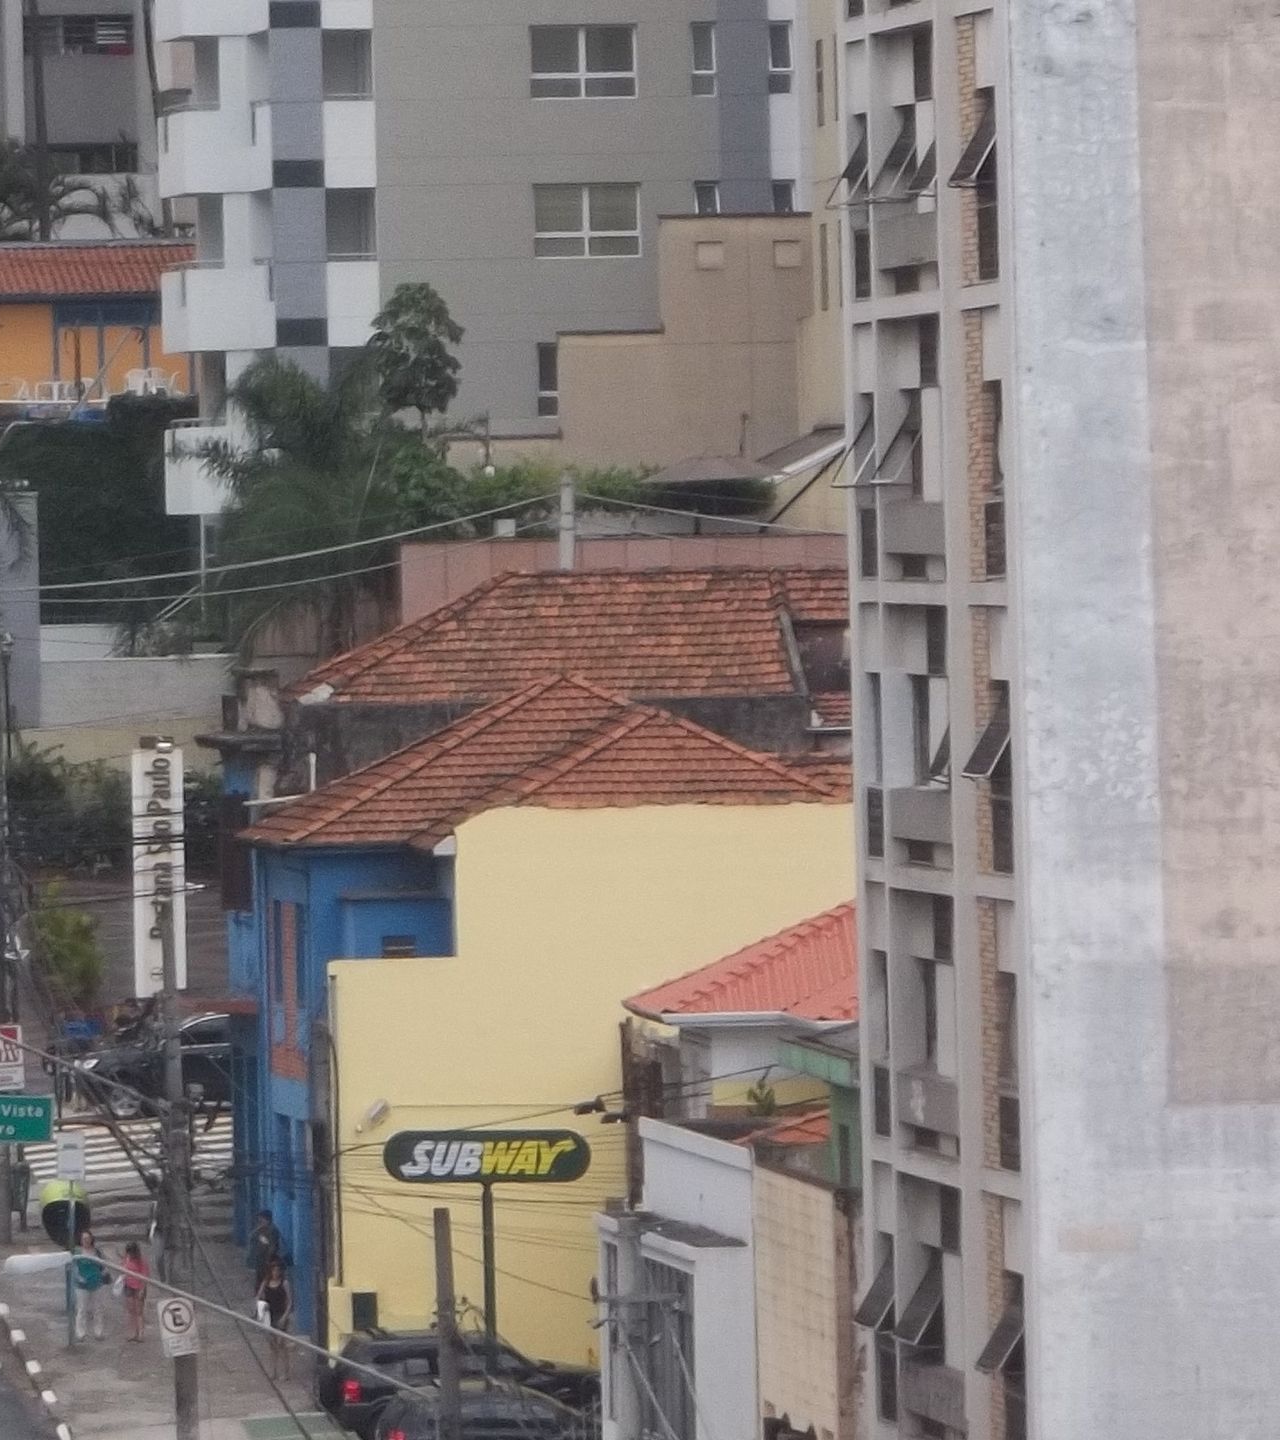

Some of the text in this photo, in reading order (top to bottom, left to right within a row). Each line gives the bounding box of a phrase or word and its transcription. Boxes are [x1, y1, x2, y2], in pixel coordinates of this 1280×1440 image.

[144, 758, 172, 816] Paulo
[0, 1103, 44, 1118] Vista
[400, 1137, 577, 1177] SUBWAY
